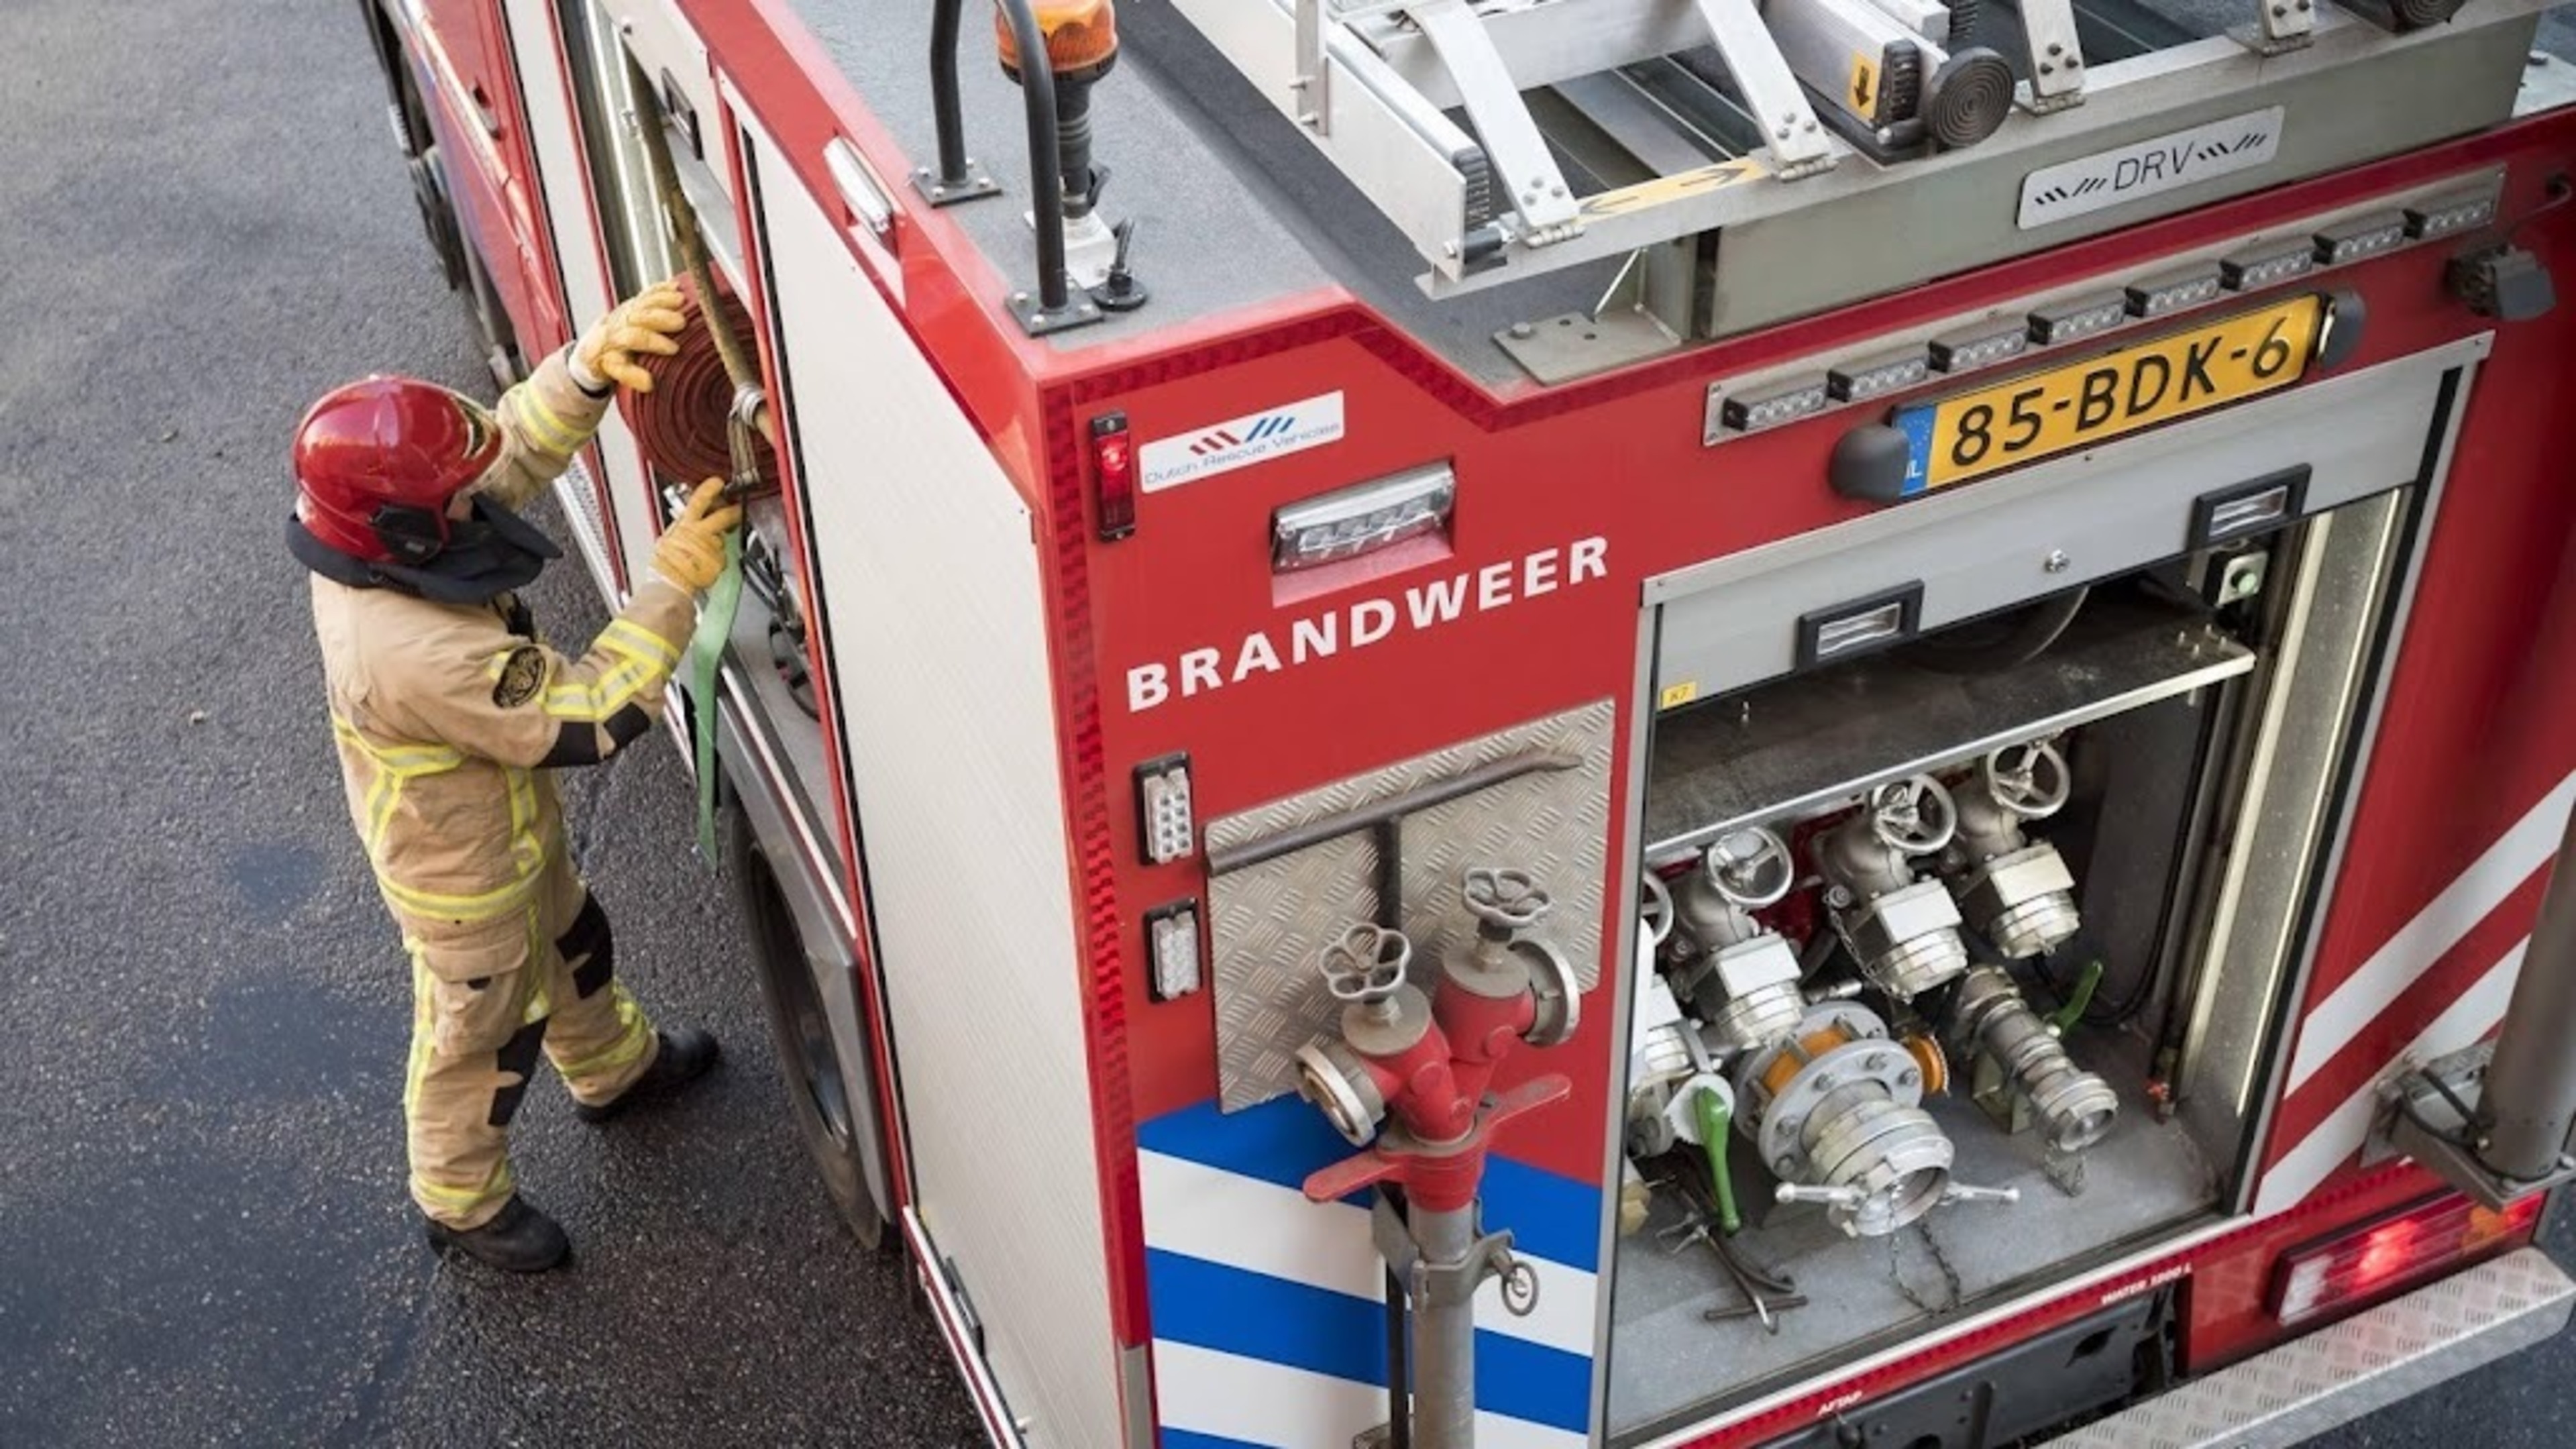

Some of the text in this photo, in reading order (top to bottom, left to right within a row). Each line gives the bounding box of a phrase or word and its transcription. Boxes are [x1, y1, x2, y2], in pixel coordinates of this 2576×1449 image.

[2114, 142, 2195, 192] DRV
[1951, 317, 2291, 468] 85-BDK-6
[1145, 423, 1340, 484] Dutch Rescue Vehicles
[1127, 537, 1609, 712] BRANDWEER
